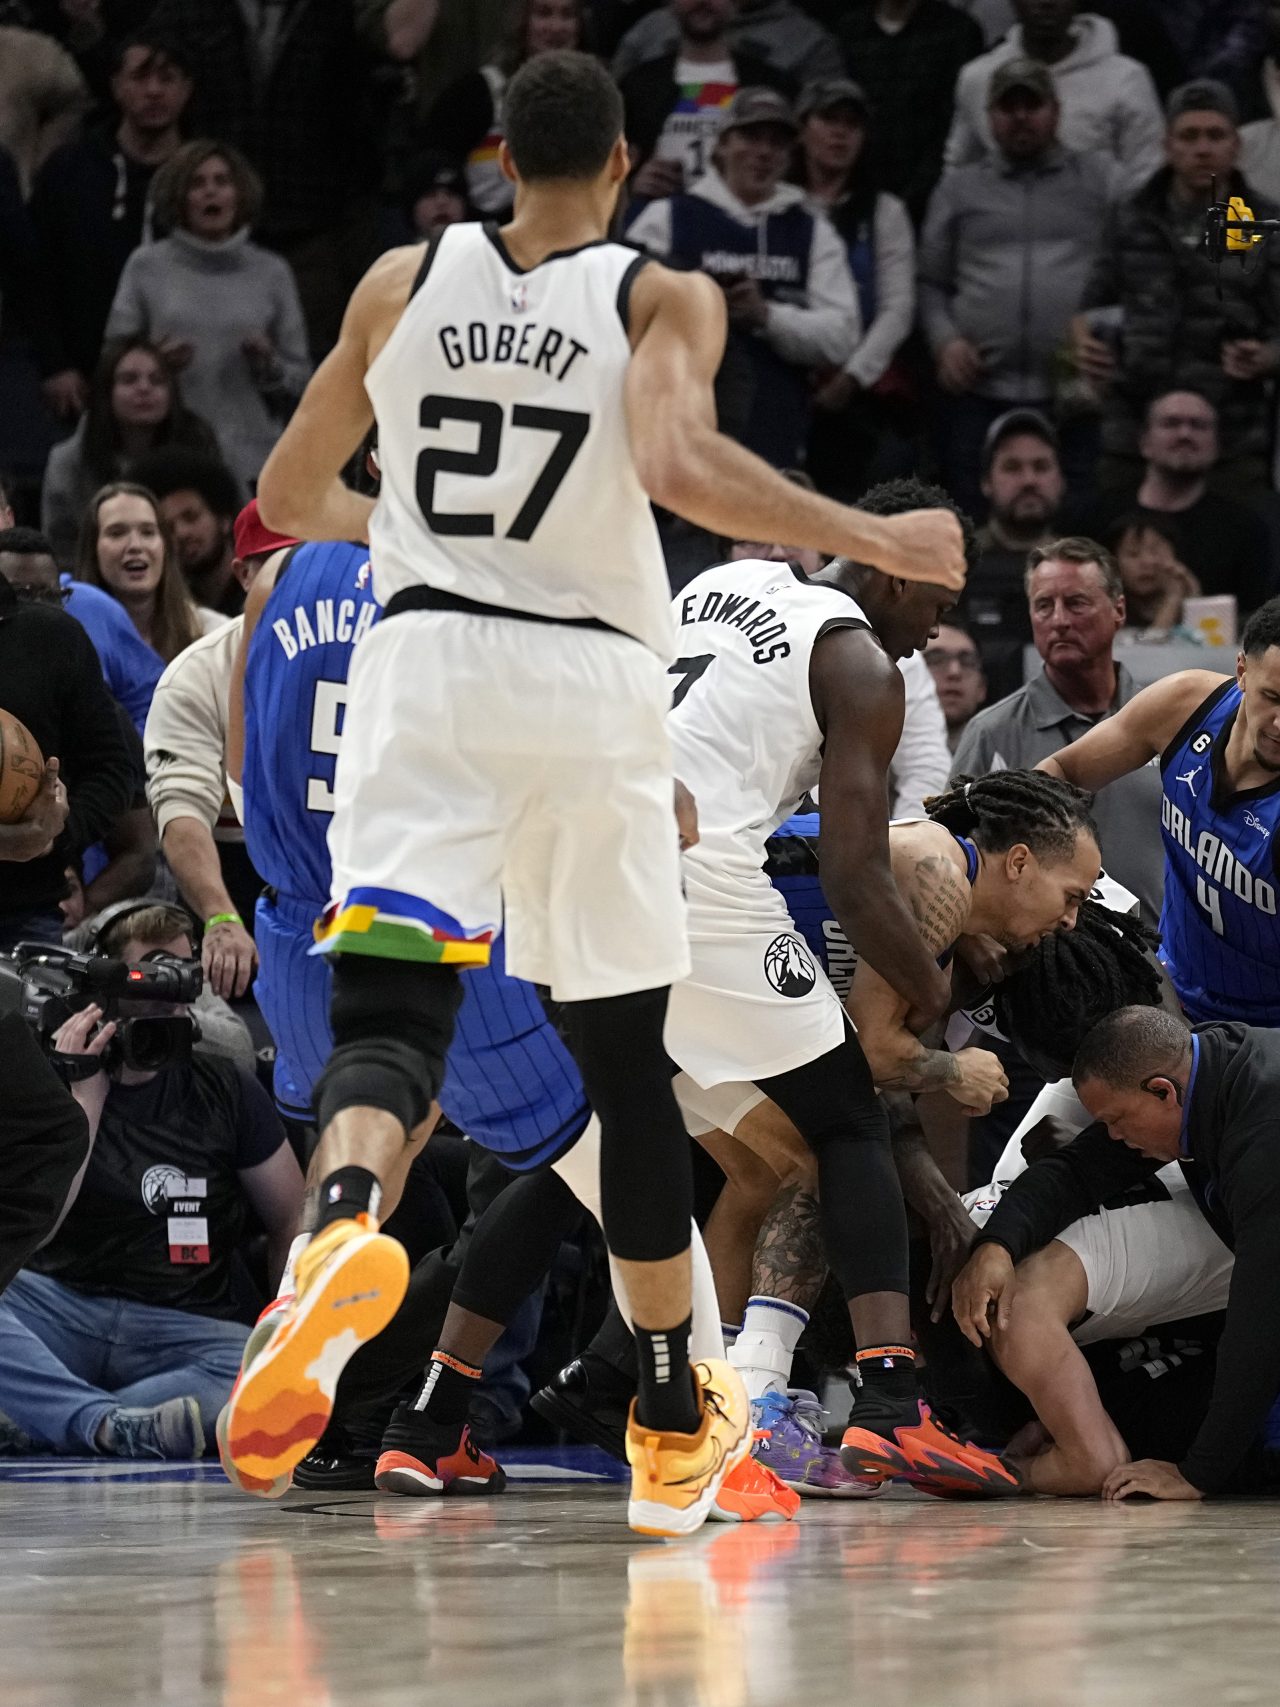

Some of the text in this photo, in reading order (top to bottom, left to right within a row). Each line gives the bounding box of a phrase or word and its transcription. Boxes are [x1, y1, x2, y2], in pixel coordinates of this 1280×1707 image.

[438, 322, 589, 382] GOBERT
[415, 394, 591, 542] 27
[680, 591, 791, 665] EDWARDS
[1192, 733, 1212, 753] 6
[1161, 791, 1277, 916] ORLANDO
[1196, 874, 1224, 937] 4
[173, 1200, 201, 1213] EVENT
[181, 1246, 199, 1260] BC
